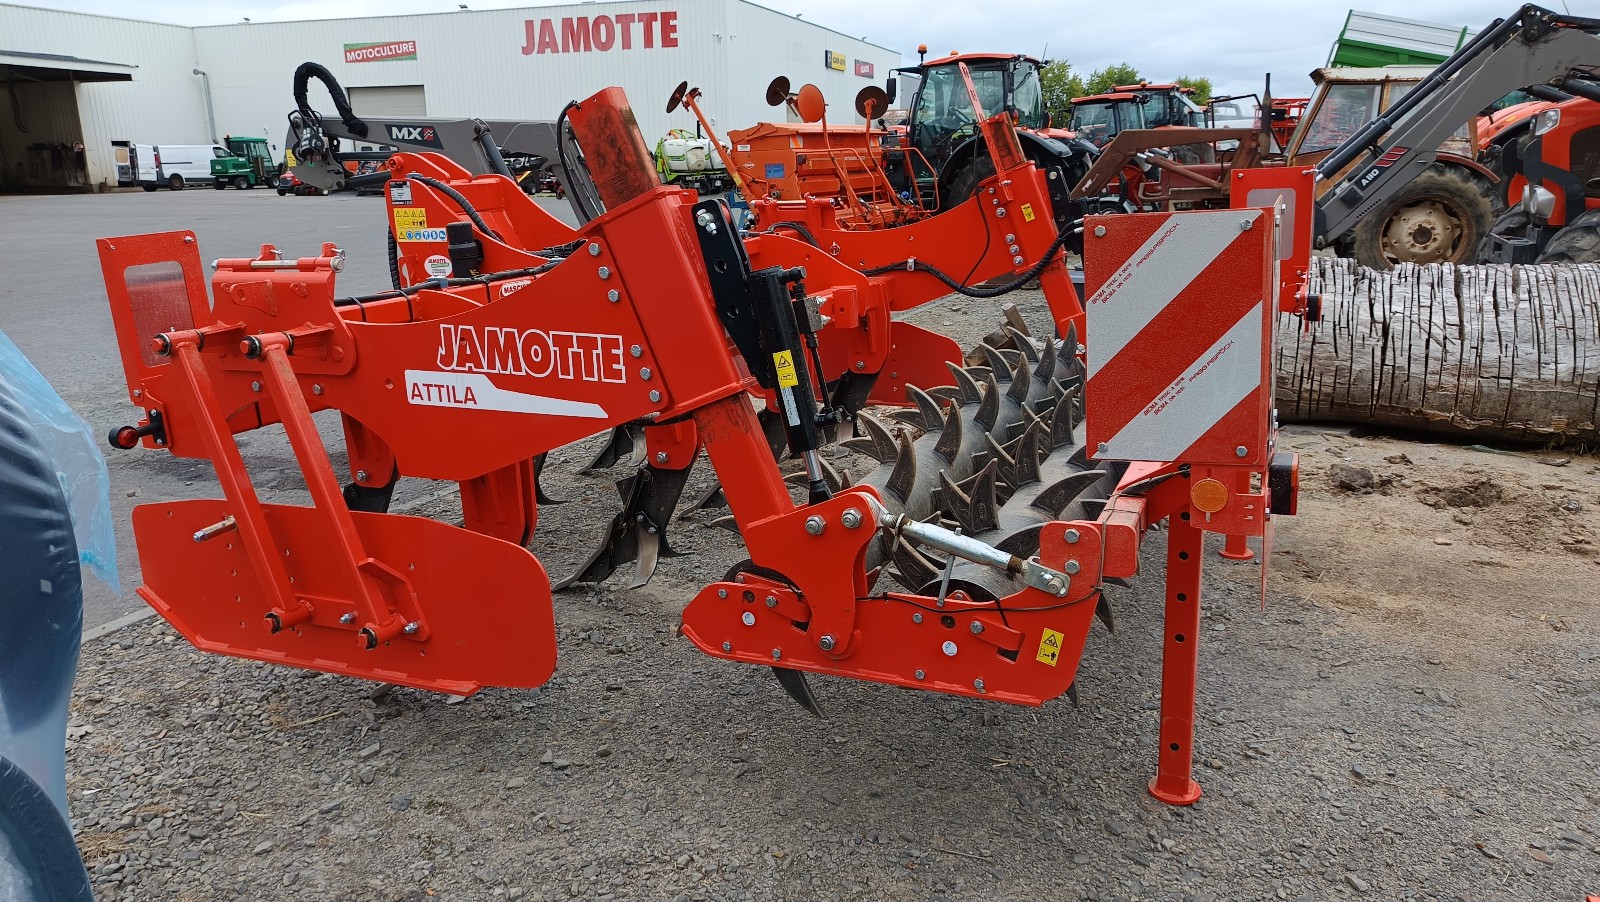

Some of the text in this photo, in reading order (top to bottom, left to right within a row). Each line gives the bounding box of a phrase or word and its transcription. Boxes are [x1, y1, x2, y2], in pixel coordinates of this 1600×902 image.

[521, 11, 679, 56] JAMOTTE
[346, 42, 415, 62] MOTOCULTURE
[391, 126, 423, 141] MX
[436, 322, 627, 385] JAMOTTE
[410, 382, 478, 406] ATTILA
